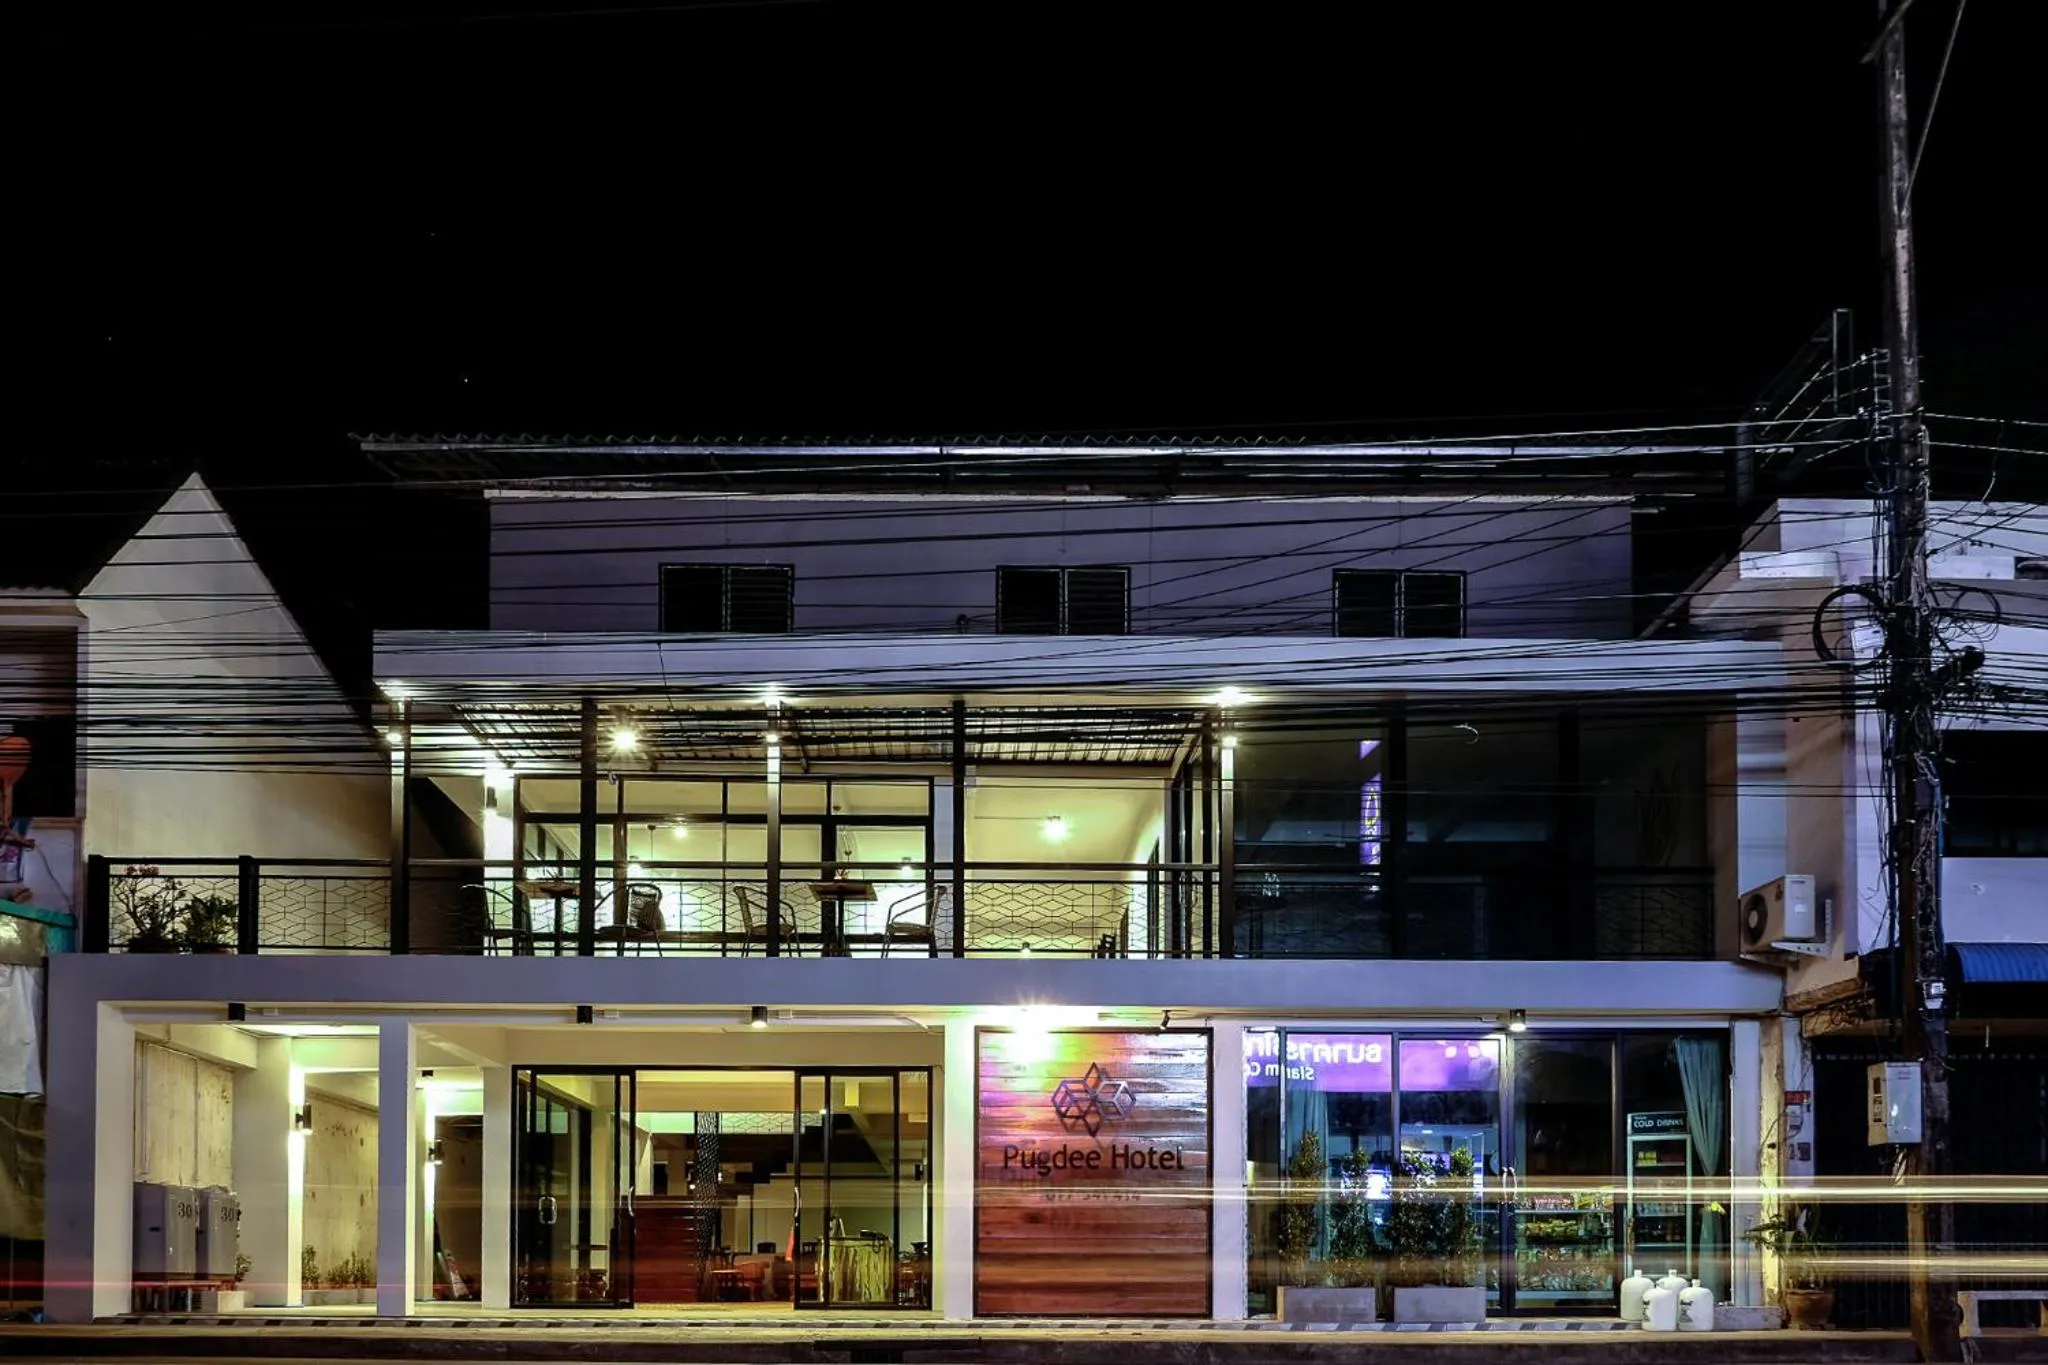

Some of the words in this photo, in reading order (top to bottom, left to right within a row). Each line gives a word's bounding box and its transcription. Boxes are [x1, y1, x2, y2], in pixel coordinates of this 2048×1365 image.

[1633, 1119, 1655, 1128] COLD
[1003, 1144, 1102, 1177] Pugdee
[1111, 1144, 1185, 1171] Hotel
